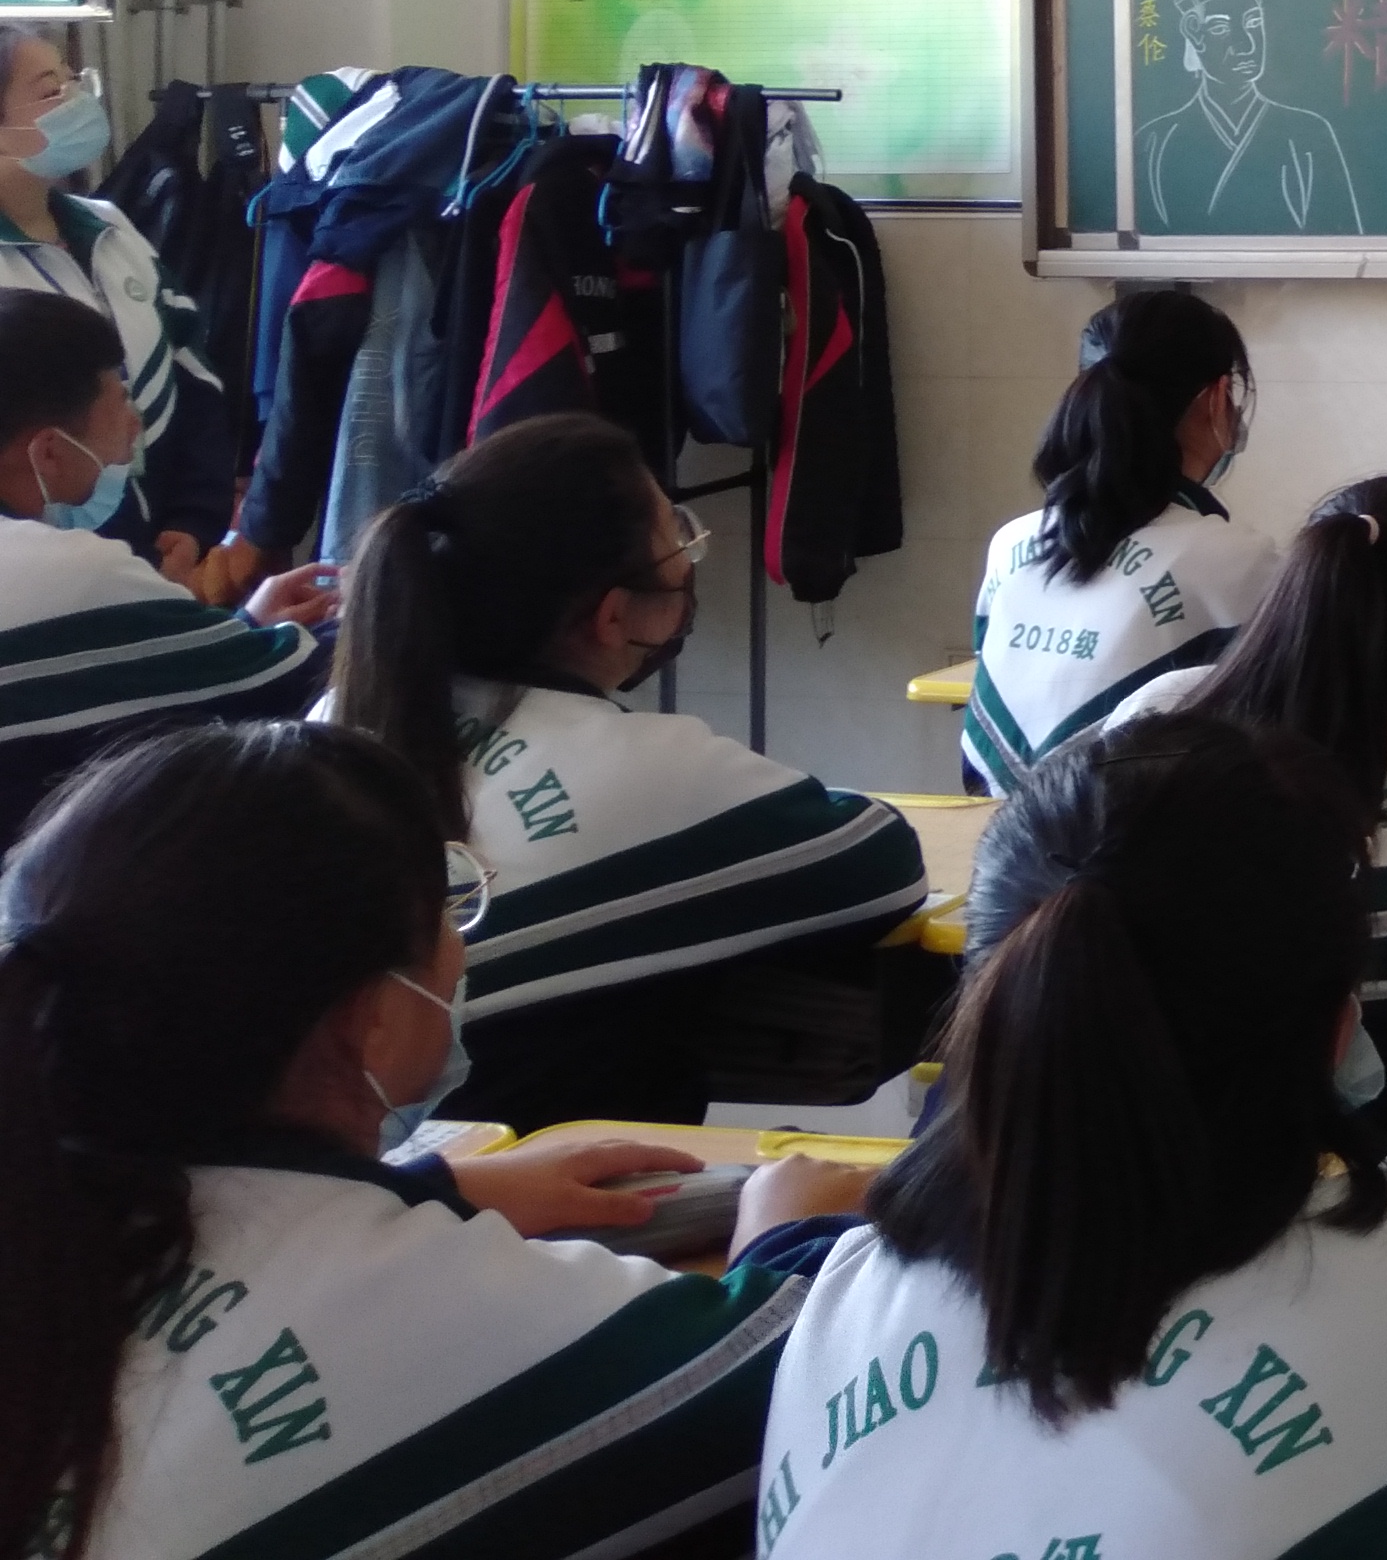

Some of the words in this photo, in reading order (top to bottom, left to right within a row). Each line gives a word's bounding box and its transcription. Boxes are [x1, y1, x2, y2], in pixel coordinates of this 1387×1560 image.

[1139, 570, 1185, 627] XIN
[1009, 622, 1101, 660] 2018级
[507, 768, 579, 843] XIN
[210, 1326, 332, 1466] XIN
[757, 1451, 802, 1560] HI
[820, 1331, 939, 1469] JIAO
[1199, 1343, 1334, 1476] XIN
